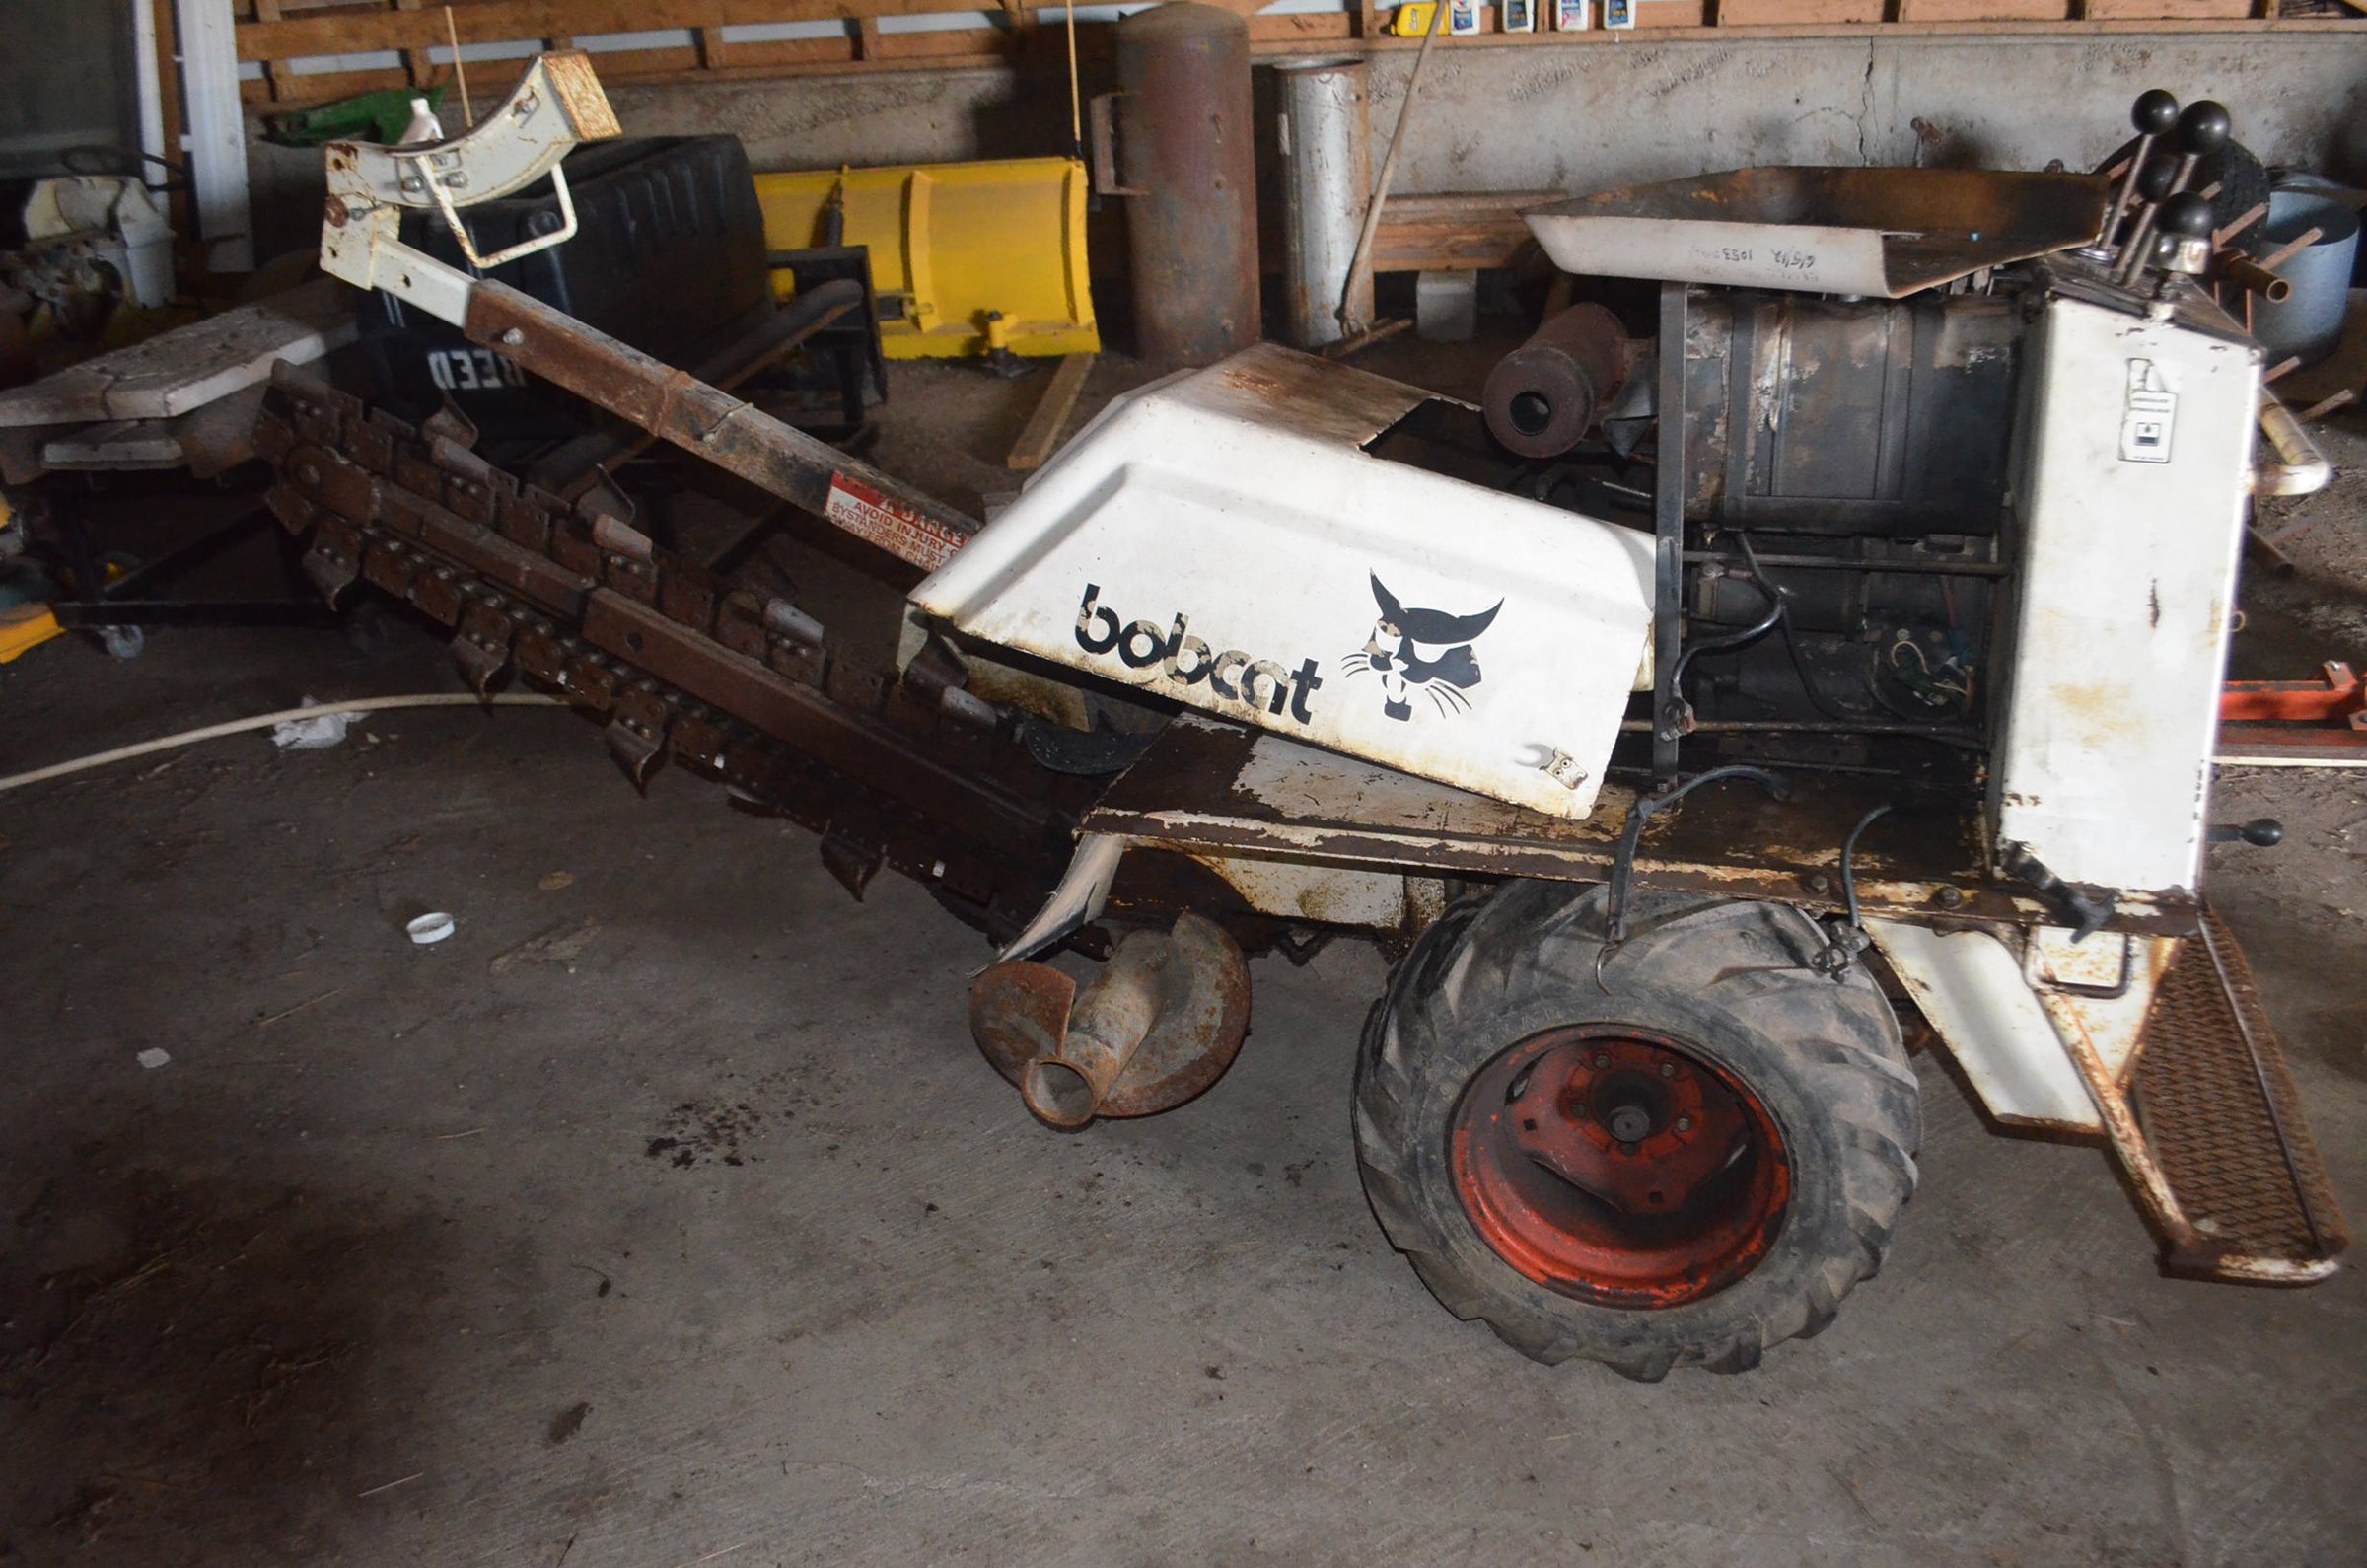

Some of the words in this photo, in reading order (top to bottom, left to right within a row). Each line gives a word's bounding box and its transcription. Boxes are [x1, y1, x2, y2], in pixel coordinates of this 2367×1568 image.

[832, 502, 907, 544] BYSTANDERS
[911, 541, 945, 563] MUST
[854, 502, 893, 526] AVOID
[897, 522, 945, 552] INJURY
[866, 533, 901, 555] FROM
[1075, 583, 1323, 725] bobcat
